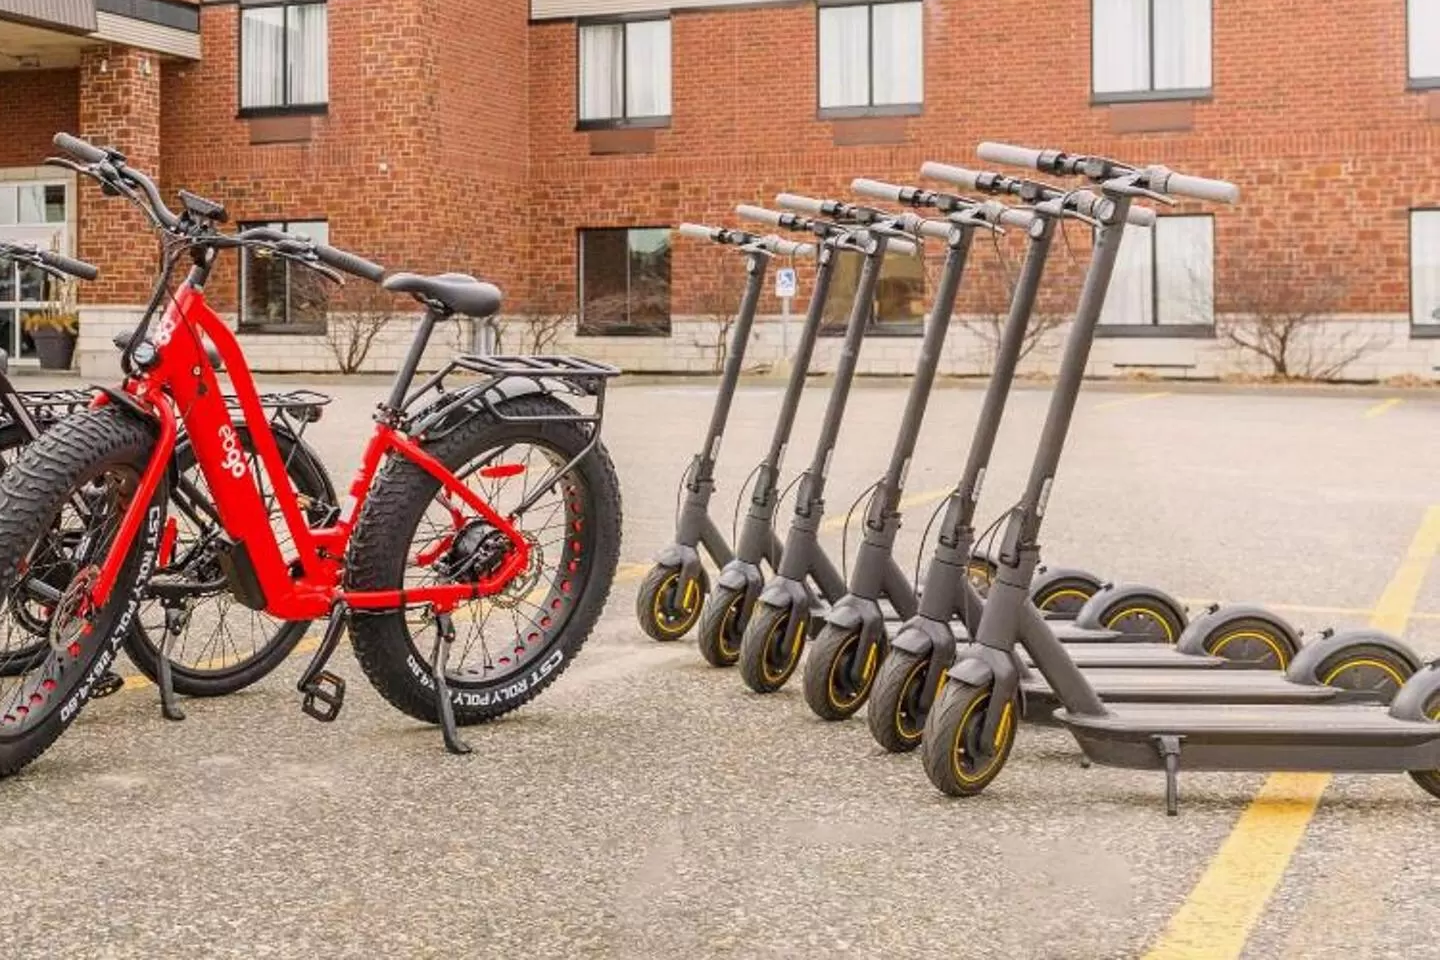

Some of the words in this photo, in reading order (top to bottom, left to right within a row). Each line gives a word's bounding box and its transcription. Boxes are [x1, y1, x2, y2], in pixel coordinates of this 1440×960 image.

[218, 424, 246, 478] ebgo
[147, 506, 160, 548] CST
[133, 551, 154, 598] ROLY
[111, 600, 137, 651] POLY
[530, 649, 564, 687] CST
[453, 692, 490, 706] POLY
[491, 678, 529, 705] ROLY
